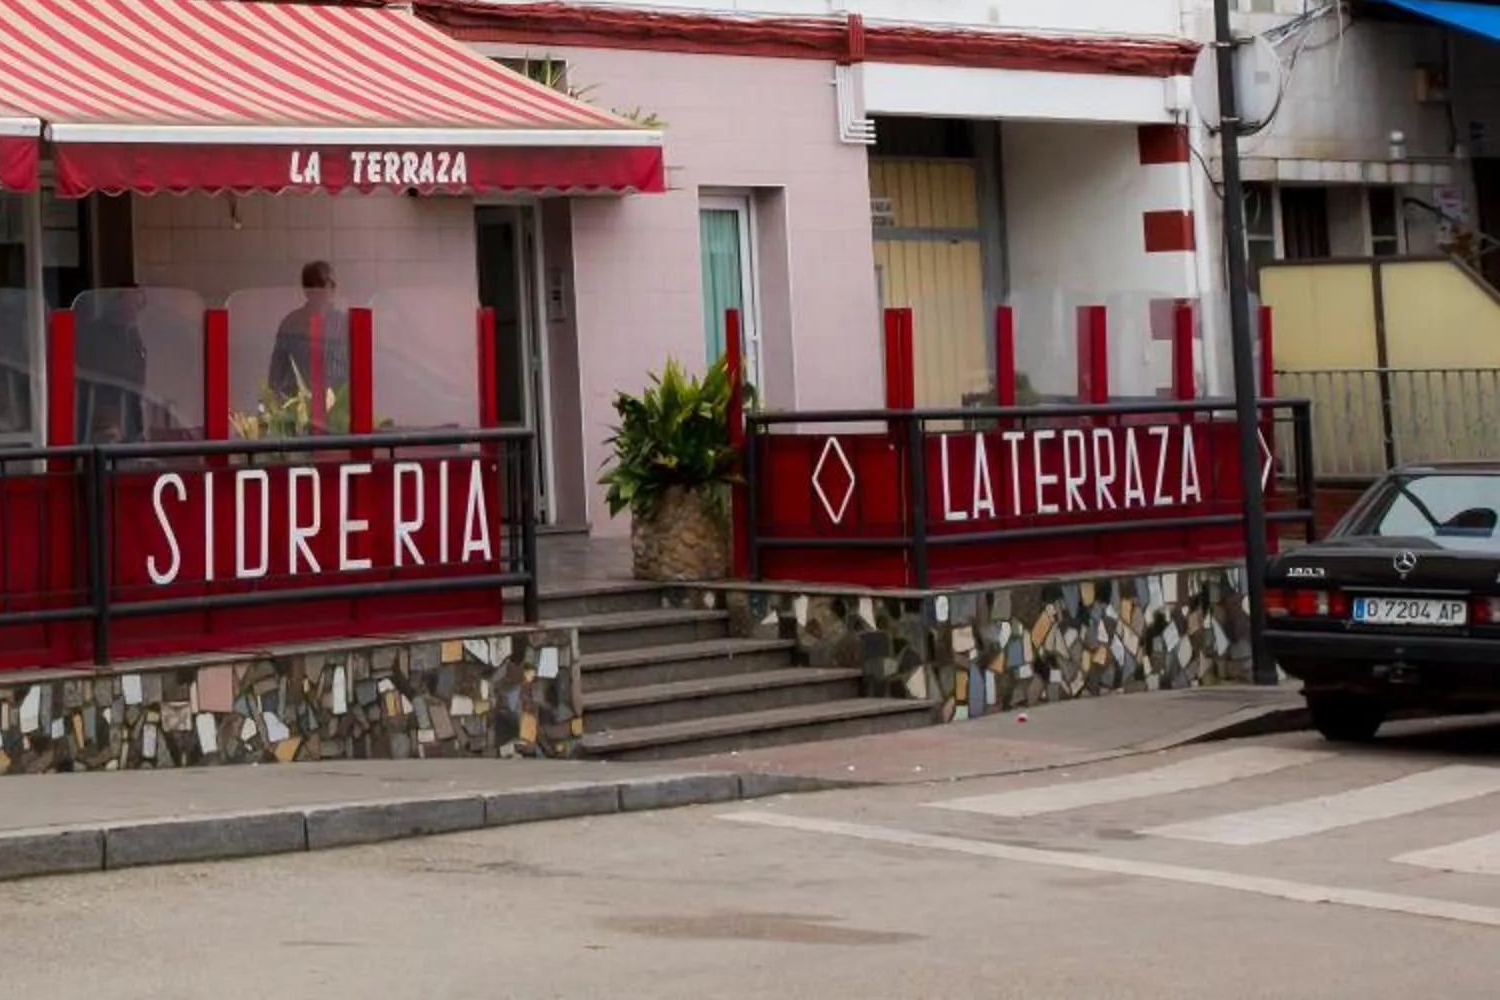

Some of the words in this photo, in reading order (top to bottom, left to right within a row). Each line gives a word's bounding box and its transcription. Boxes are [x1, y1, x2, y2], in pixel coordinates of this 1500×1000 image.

[289, 150, 321, 185] LA
[350, 151, 467, 186] TERRAZA
[147, 459, 492, 585] SIDRERIA
[1385, 601, 1431, 619] 7204
[1439, 602, 1463, 620] AP
